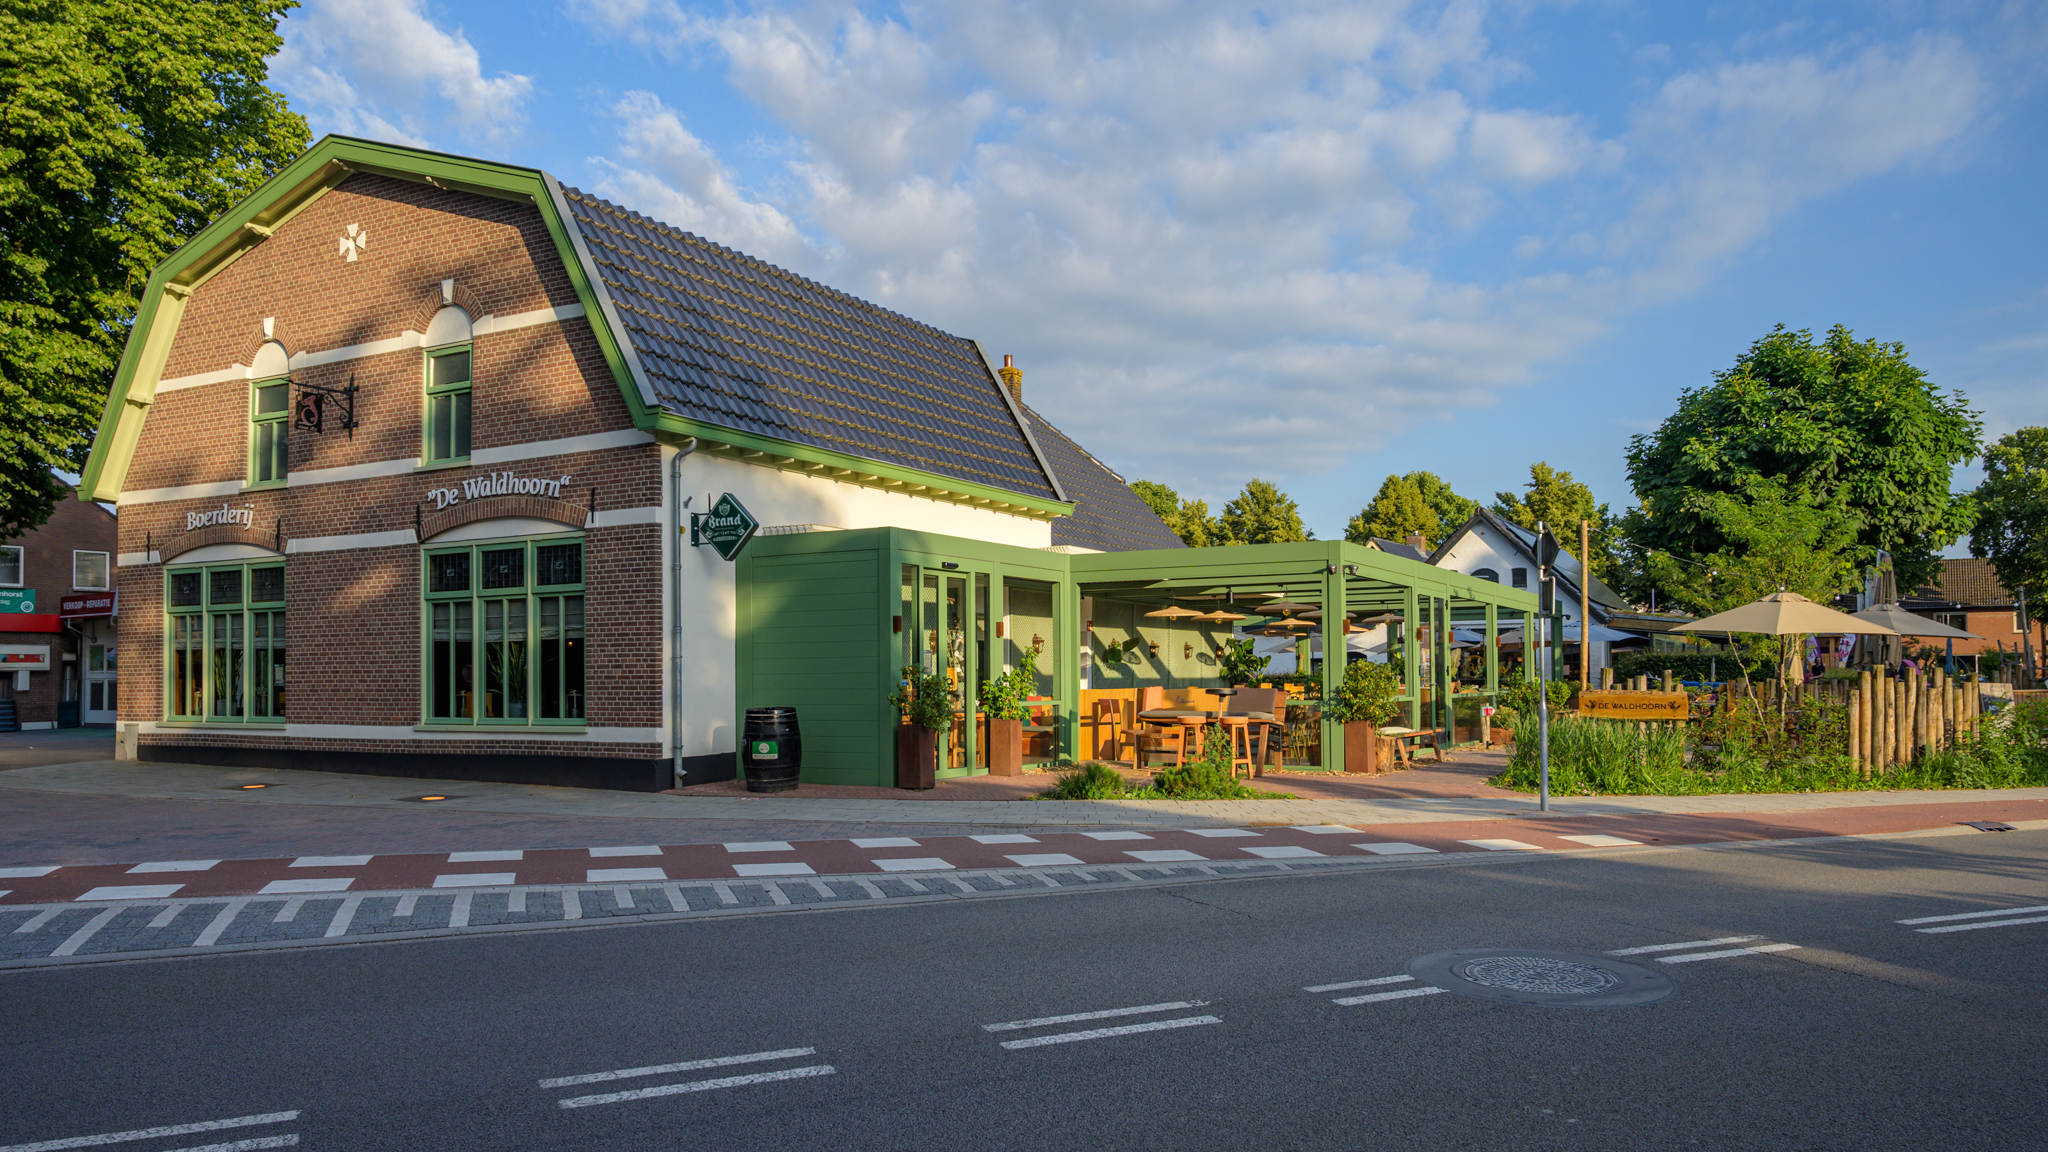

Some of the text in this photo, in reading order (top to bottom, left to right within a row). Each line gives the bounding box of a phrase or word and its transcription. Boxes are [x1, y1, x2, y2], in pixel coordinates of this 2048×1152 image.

[186, 503, 254, 531] Boerderij
[708, 514, 742, 528] Brand
[63, 600, 83, 610] VERKOOP
[86, 598, 111, 608] REPARATIE
[1598, 702, 1667, 710] DE WALDHOORN
